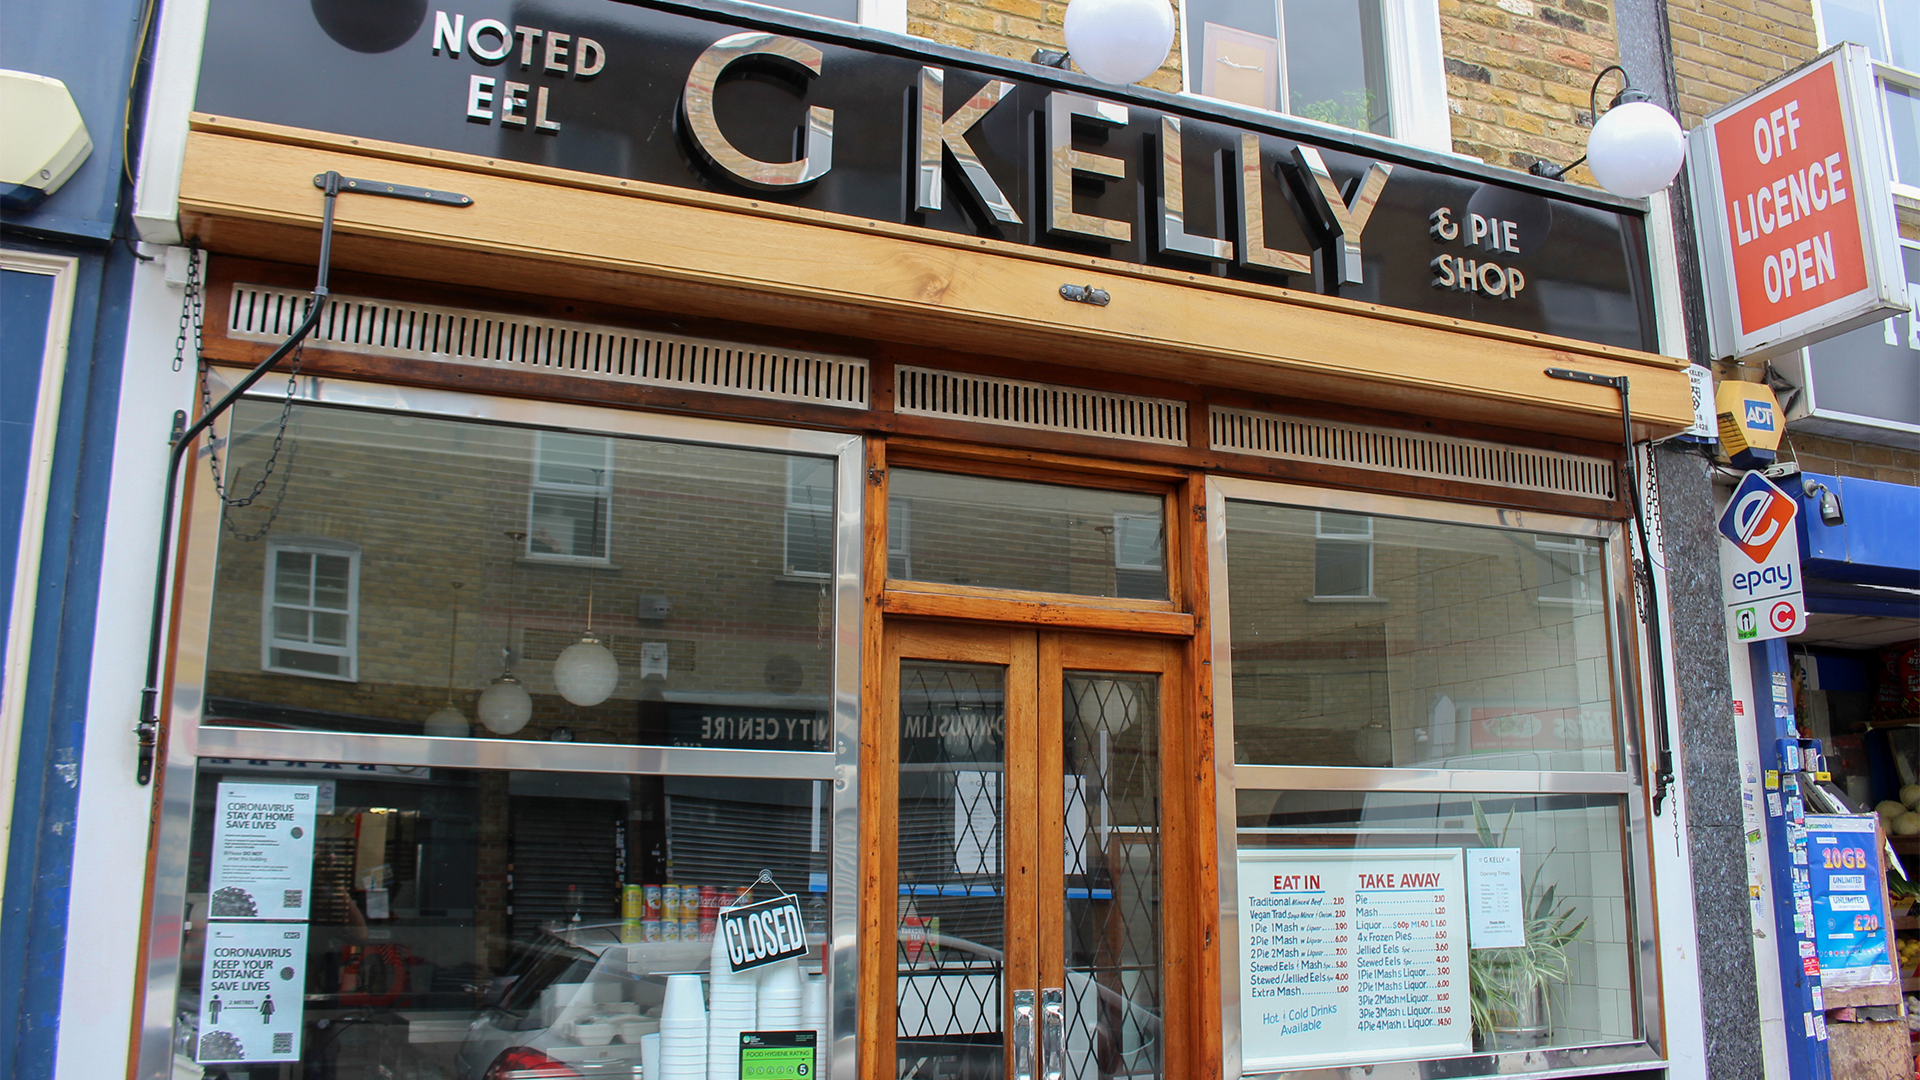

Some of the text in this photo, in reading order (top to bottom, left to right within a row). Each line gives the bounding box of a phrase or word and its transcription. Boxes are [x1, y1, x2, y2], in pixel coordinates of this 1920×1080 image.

[432, 10, 606, 79] NOTED
[467, 75, 561, 136] EEL
[1753, 100, 1800, 165] OFF
[682, 32, 1394, 285] G KELLY
[1733, 151, 1847, 246] LICENCE
[1432, 207, 1520, 253] & PIE
[1763, 231, 1836, 304] OPEN
[1432, 253, 1525, 299] SHOP
[1746, 406, 1772, 425] ADT
[1732, 563, 1793, 595] epay
[227, 802, 294, 812] CORONAVIRUS
[227, 812, 294, 821] STAY AT HOME
[226, 820, 277, 829] SAVE LIVES
[1822, 847, 1867, 870] 10GB
[1274, 875, 1320, 890] EAT IN
[1359, 873, 1440, 888] TAKE AWAY
[1249, 896, 1290, 907] Traditional
[1356, 894, 1368, 905] Pie
[1833, 896, 1865, 904] UNLIMITED
[1250, 910, 1270, 921] Vegan
[1272, 909, 1286, 919] Trad
[1356, 908, 1378, 917] Mash
[1335, 922, 1347, 931] 3.90
[1356, 920, 1382, 931] Liquor
[1853, 914, 1879, 931] £20
[725, 904, 804, 966] CLOSED
[1335, 935, 1348, 943] 6.00
[1369, 931, 1394, 942] Frozen
[1395, 931, 1412, 940] Pies
[214, 948, 292, 957] CORONAVIRUS
[1356, 944, 1381, 955] Jellied
[1383, 944, 1400, 954] Eels
[1435, 943, 1449, 951] 3.60
[213, 960, 273, 969] KEEP YOUR
[1250, 961, 1278, 973] Stewed
[1279, 962, 1295, 971] Eels
[1301, 960, 1322, 970] Mash
[1357, 957, 1384, 968] Stewed
[1385, 957, 1401, 966] Eels
[1436, 955, 1450, 963] 4.00
[212, 970, 264, 979] DISTANCE
[1310, 972, 1326, 982] Eels
[1403, 968, 1427, 979] Liquor
[1437, 967, 1450, 975] 3.90
[211, 982, 270, 991] SAVE LIVES
[1252, 985, 1349, 998] Extra Mash 1.00
[1404, 980, 1427, 991] Liquor
[1406, 993, 1429, 1005] Liquor
[1263, 1012, 1279, 1025] Hot
[1289, 1008, 1308, 1021] Cold
[1311, 1004, 1337, 1017] Drinks
[1407, 1006, 1431, 1017] Liquor
[1280, 1019, 1322, 1036] Available
[1408, 1018, 1433, 1030] Liquor
[799, 1064, 807, 1075] 5
